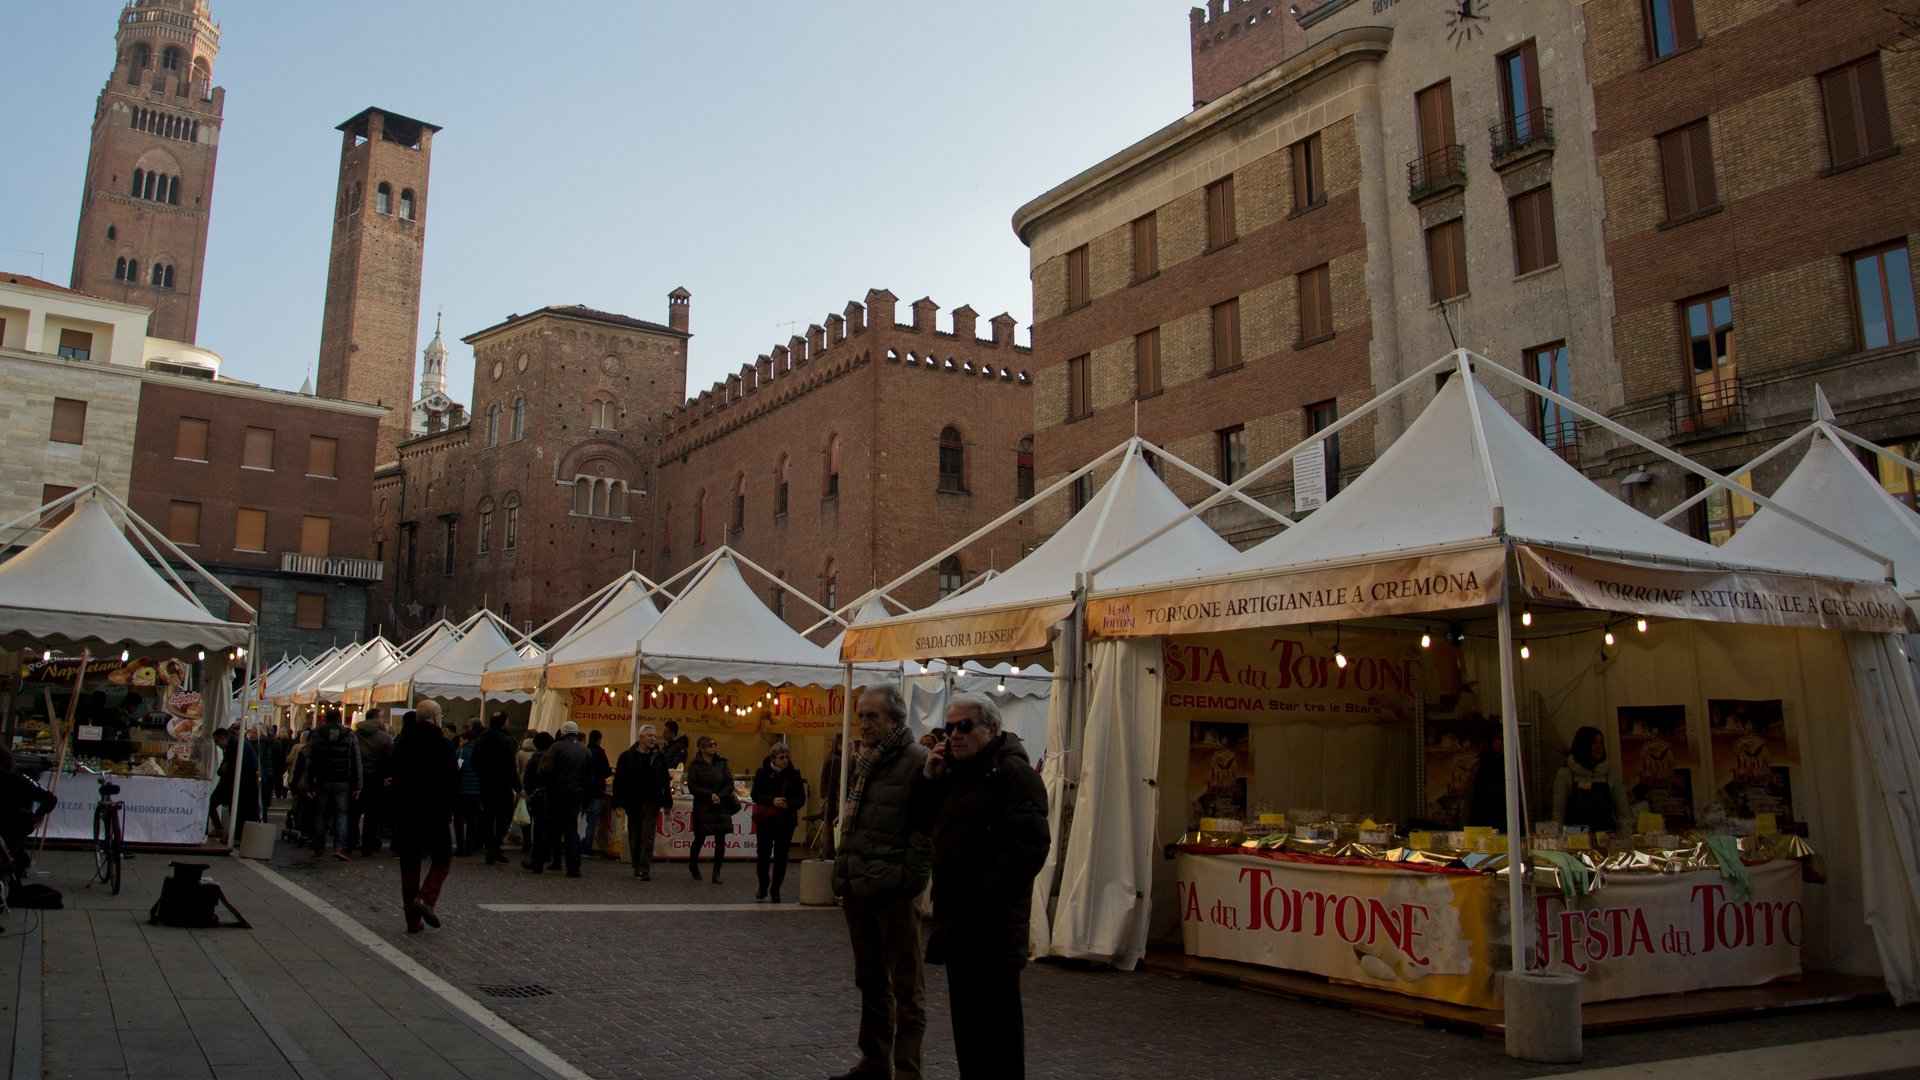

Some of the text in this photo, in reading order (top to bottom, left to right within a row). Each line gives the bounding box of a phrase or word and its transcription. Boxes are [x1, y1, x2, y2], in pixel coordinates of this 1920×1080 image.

[1146, 570, 1480, 625] TORRONE ARTIGIANALE A CREMONA
[1595, 579, 1900, 621] TORRONE ARTIGIANALE A CREMONA
[915, 627, 1022, 651] SPADAFORA DESSERT
[41, 661, 122, 681] Napetana
[1168, 693, 1382, 714] CREMONA Star tra le Stars
[574, 712, 633, 722] CREMONA
[797, 721, 825, 729] CREMONA
[125, 805, 194, 816] MEDIORIENTALI
[673, 840, 741, 849] CRMONA
